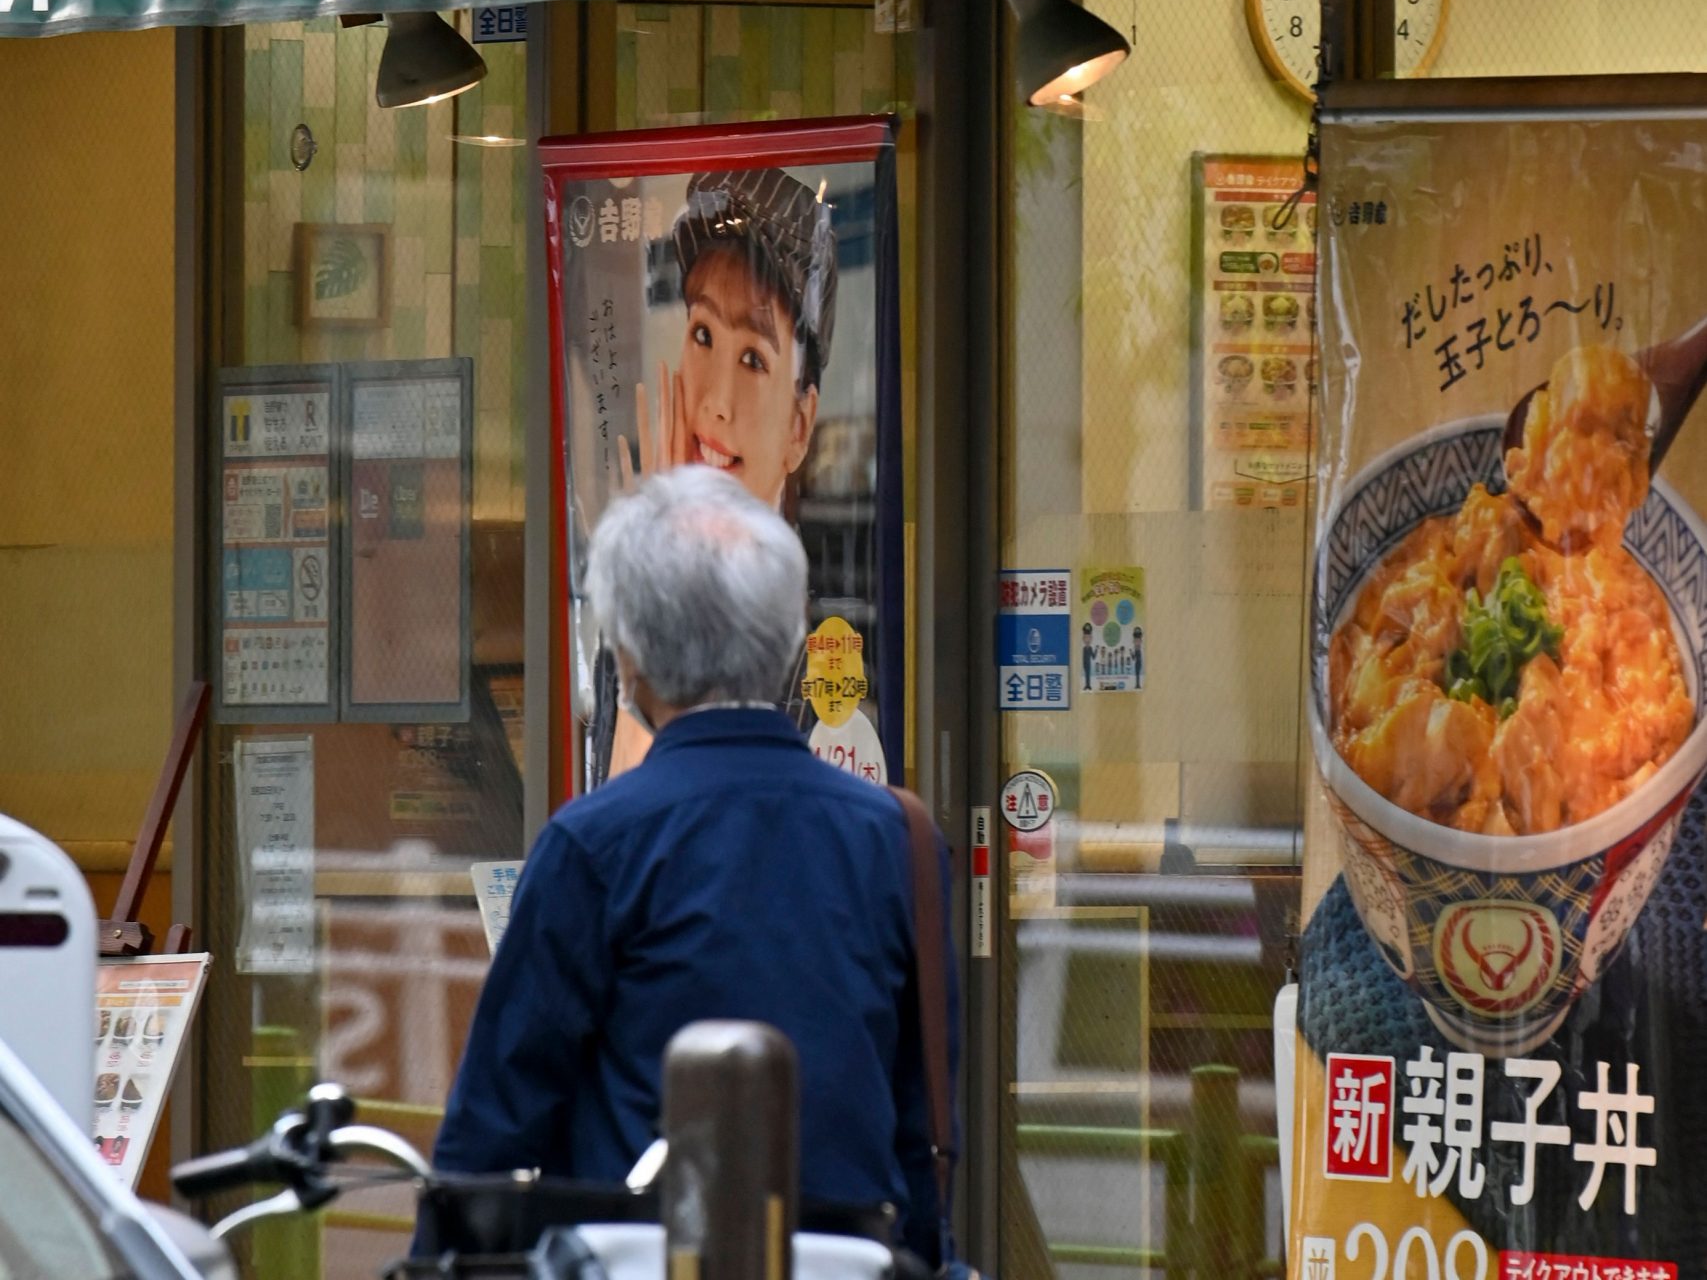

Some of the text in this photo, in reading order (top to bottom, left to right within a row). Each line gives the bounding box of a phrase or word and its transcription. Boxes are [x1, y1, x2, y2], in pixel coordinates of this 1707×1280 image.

[1289, 16, 1303, 37] 8
[1396, 19, 1410, 41] 4
[1006, 673, 1062, 702] 全日警
[1333, 1045, 1657, 1215] 新 親子丼
